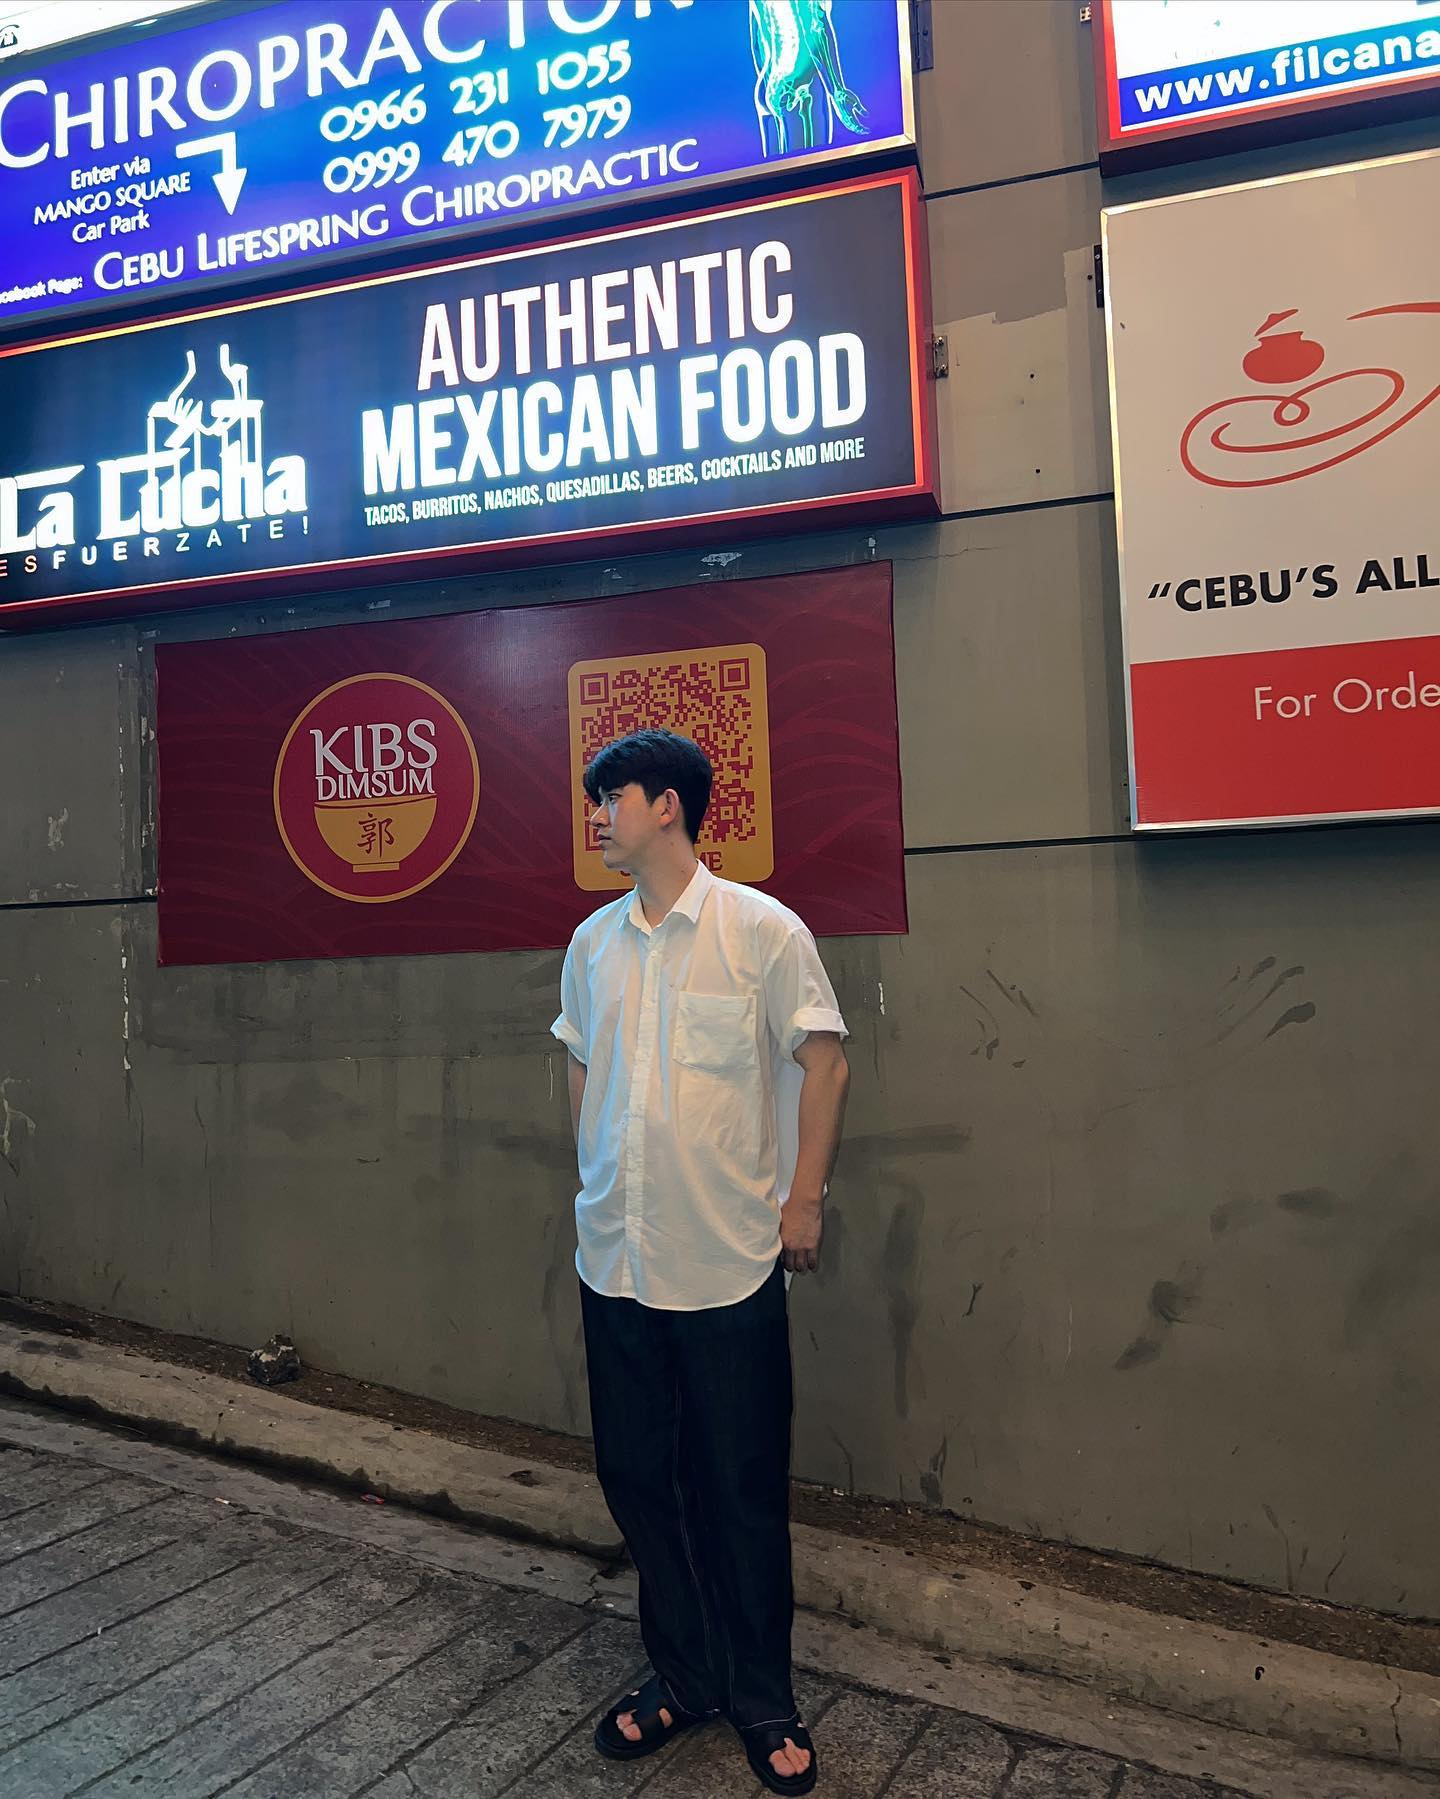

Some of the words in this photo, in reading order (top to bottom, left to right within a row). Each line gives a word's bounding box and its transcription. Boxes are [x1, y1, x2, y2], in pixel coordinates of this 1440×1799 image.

[0, 0, 694, 168] CHIROPRACTO
[319, 83, 426, 143] 0966
[449, 68, 509, 116] 231
[536, 40, 632, 95] 1055
[71, 163, 120, 190] Enter
[124, 155, 151, 177] via
[323, 141, 420, 194] 0999
[442, 121, 520, 168] 470
[543, 94, 632, 149] 7979
[0, 280, 46, 304] cebook
[94, 246, 184, 290] CEBU
[197, 204, 389, 271] LIFESPRING
[402, 138, 700, 228] CHIROPRACTIC
[34, 192, 112, 225] MANGO
[115, 171, 191, 208] SQUARE
[72, 222, 106, 243] Car
[110, 209, 151, 236] Park
[417, 240, 794, 392] AUTHENTIC
[361, 363, 659, 496] MEXICAN
[679, 331, 868, 450] FOOD
[0, 464, 85, 554] La
[96, 440, 308, 541] Lucha
[364, 503, 410, 527] TACOS,
[412, 493, 482, 521] BURRITOS,
[484, 484, 543, 510] NACHOS,
[546, 469, 645, 503] QUESADILLAS,
[647, 462, 699, 489] BEERS,
[701, 449, 782, 480] COCKTAILS
[784, 444, 817, 469] AND
[820, 437, 866, 465] MORE
[1355, 554, 1440, 594] ALL
[1254, 686, 1317, 721] For
[1332, 670, 1440, 714] Orde
[309, 719, 438, 776] KIBS
[315, 768, 436, 801] DIMSUM
[356, 812, 395, 859] 郭
